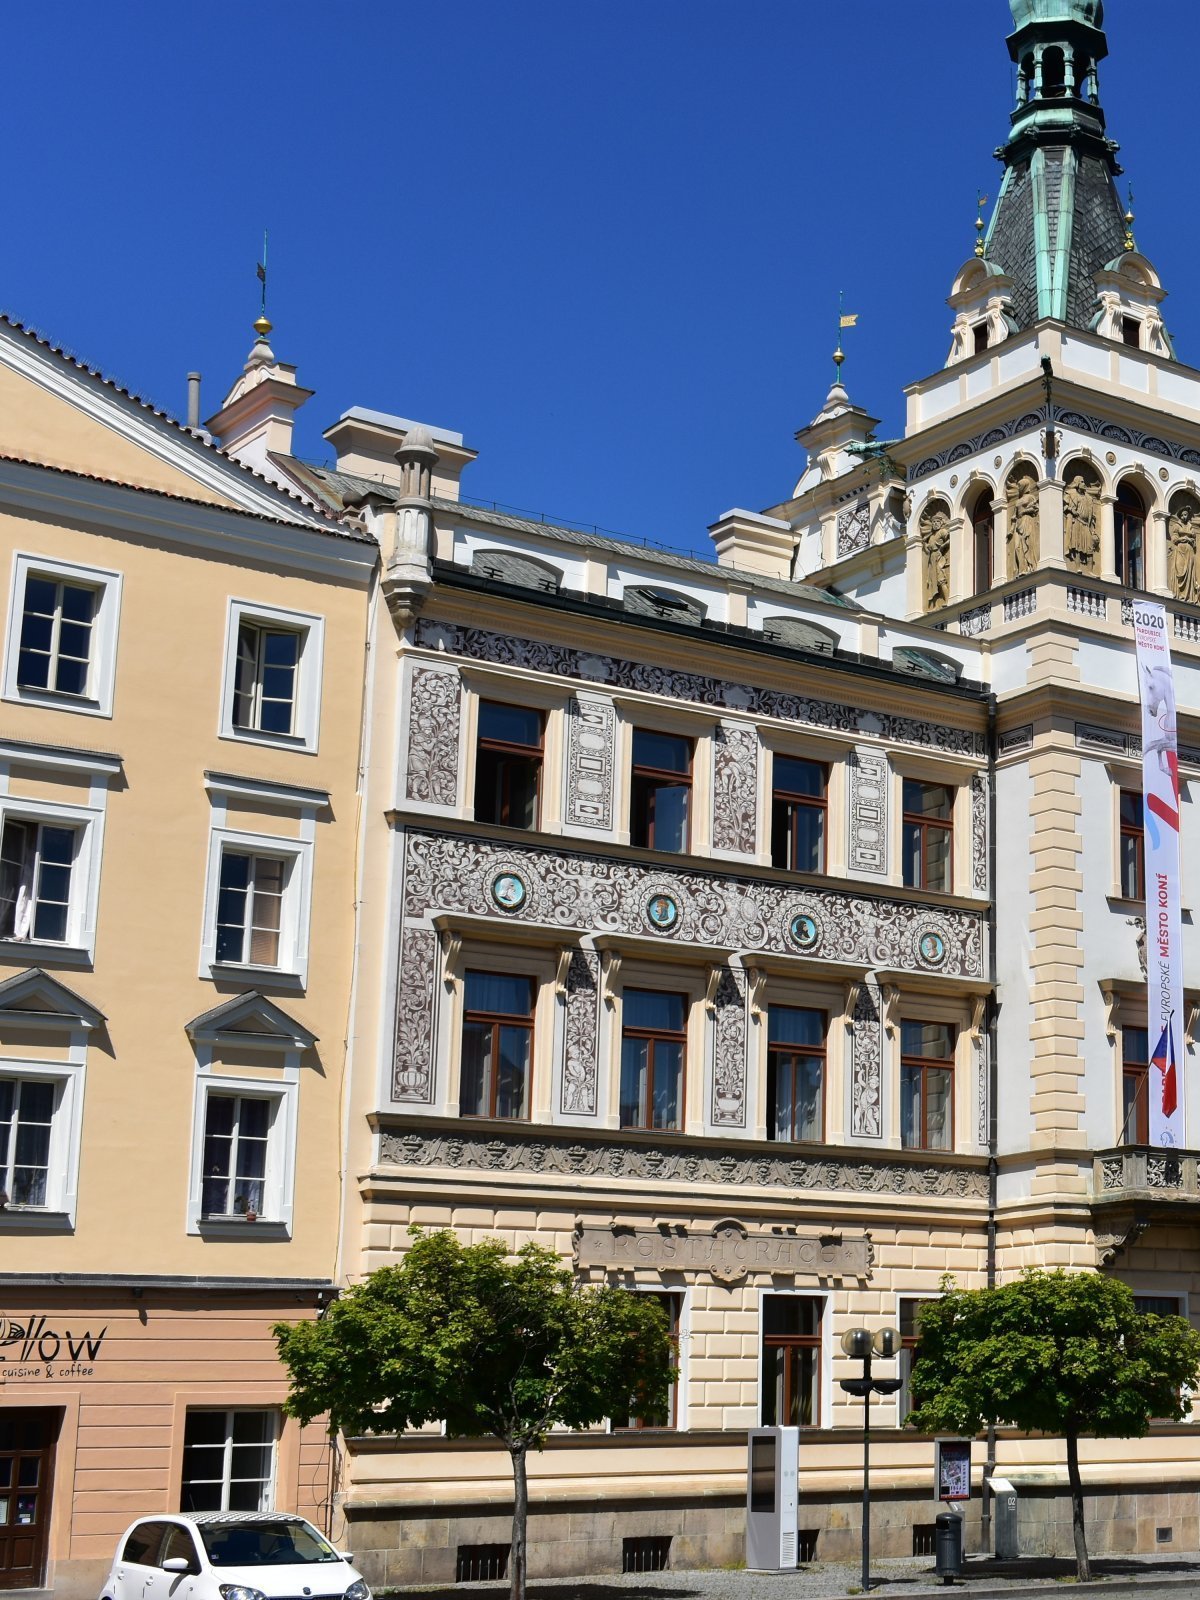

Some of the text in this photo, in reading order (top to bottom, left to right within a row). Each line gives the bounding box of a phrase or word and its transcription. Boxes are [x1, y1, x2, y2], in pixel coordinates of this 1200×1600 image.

[1135, 611, 1164, 629] 2020
[1155, 873, 1168, 908] KONÍ
[1157, 912, 1169, 957] MĚSTO
[1158, 961, 1171, 1023] EVROPSKÉ
[611, 1235, 839, 1264] RESTAURACE
[2, 1363, 94, 1379] cuisine & coffee
[1007, 1497, 1016, 1505] 02
